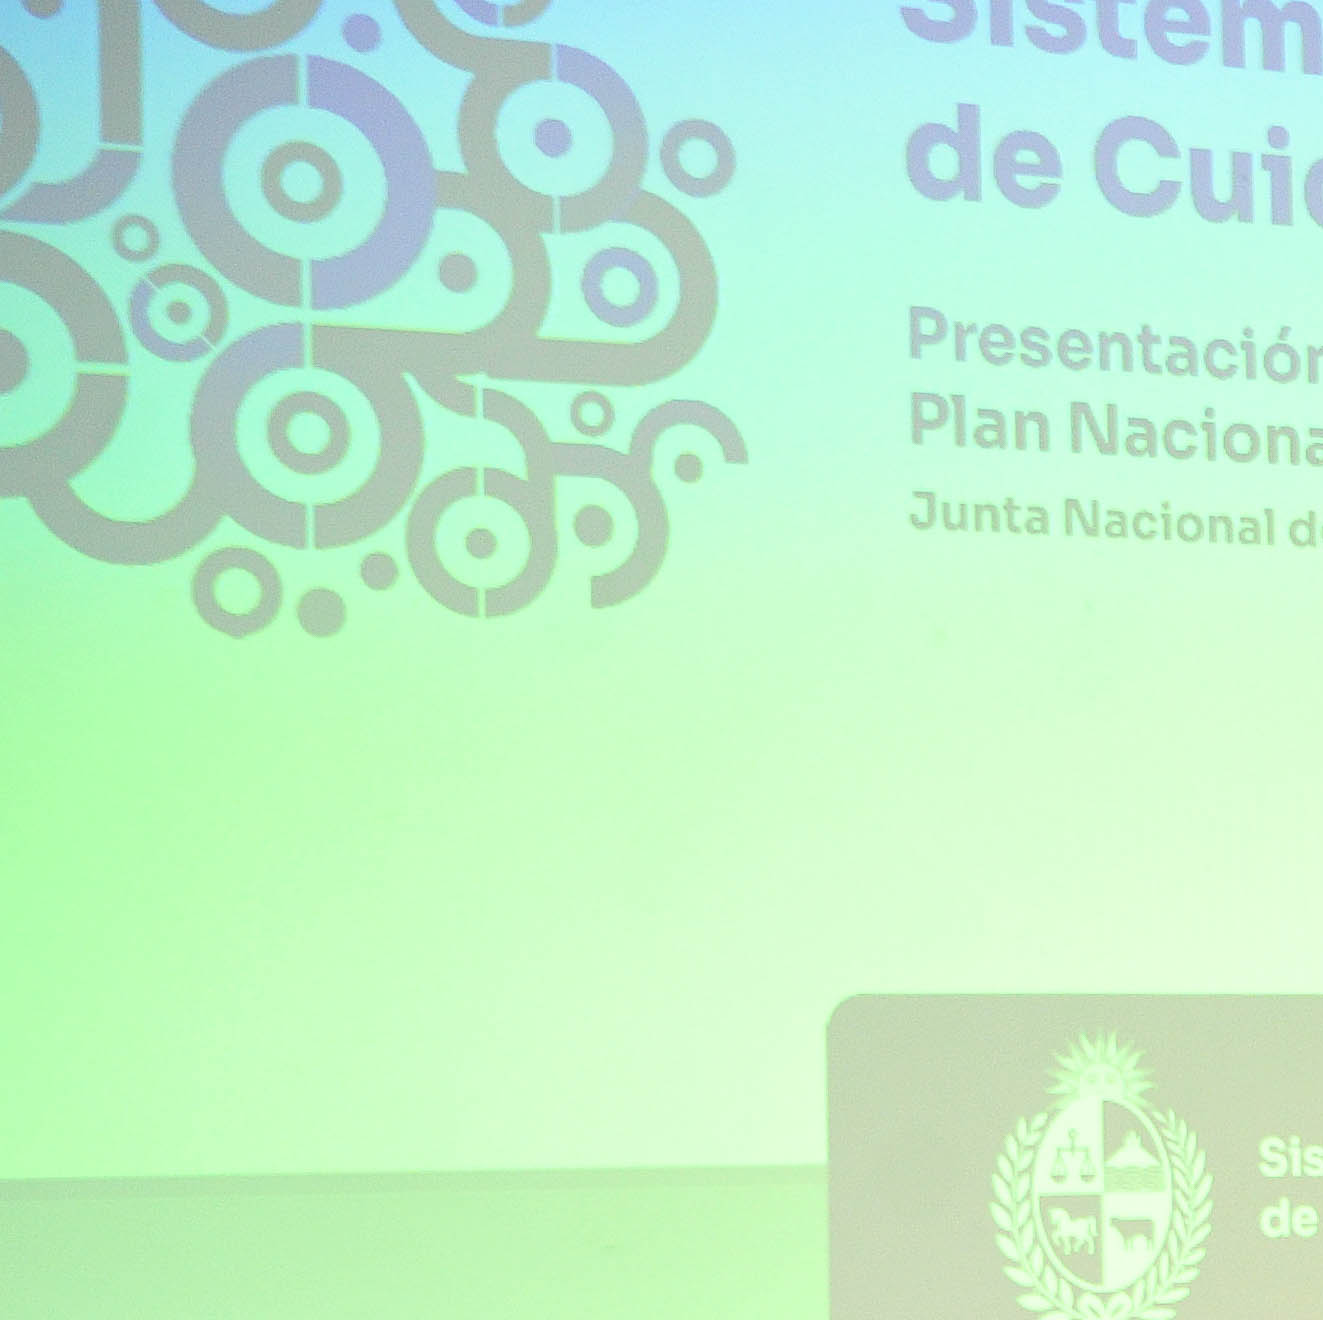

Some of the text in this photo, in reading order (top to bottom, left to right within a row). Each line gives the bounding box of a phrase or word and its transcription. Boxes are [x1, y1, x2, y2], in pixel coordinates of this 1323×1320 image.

[905, 101, 1063, 209] de
[910, 391, 1050, 452] Plan
[908, 491, 1051, 536] Junta
[1064, 497, 1275, 547] Nacional
[1259, 1196, 1319, 1238] de
